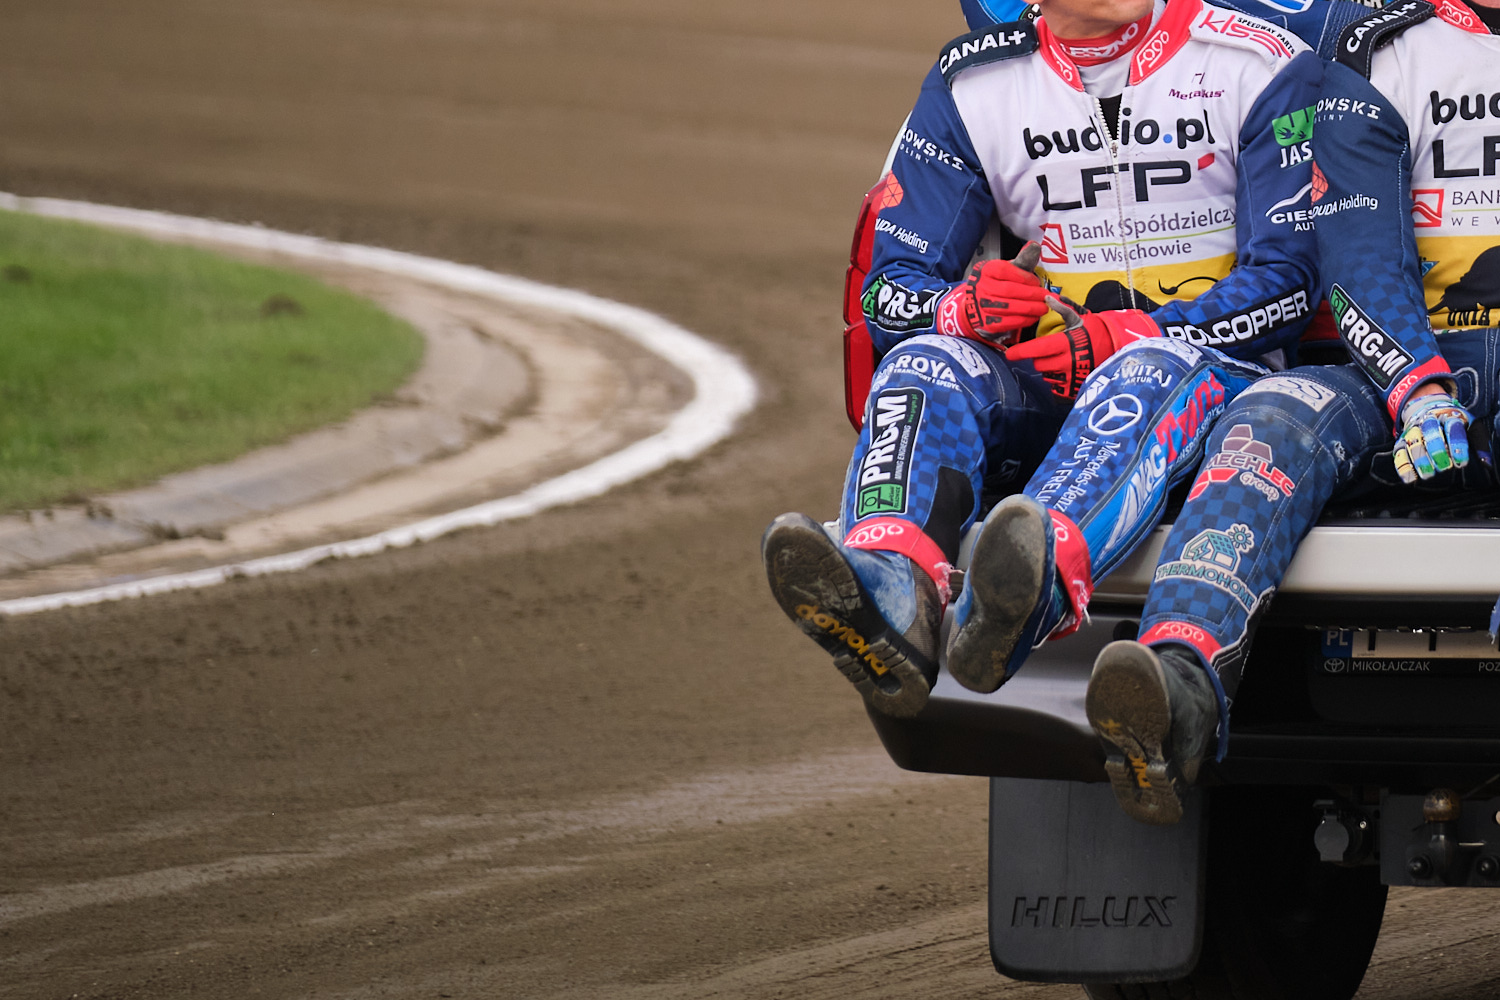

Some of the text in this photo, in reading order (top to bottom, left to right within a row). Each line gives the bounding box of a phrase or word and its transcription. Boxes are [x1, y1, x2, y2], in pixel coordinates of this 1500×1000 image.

[1237, 17, 1296, 56] SPEEDWAY PARTS
[1346, 1, 1418, 53] CANAL+
[939, 30, 1027, 74] CANAL+
[1136, 30, 1170, 77] Fogo
[1022, 108, 1216, 161] budio.pl
[1036, 159, 1192, 213] LFP
[1338, 195, 1379, 211] Holding
[1069, 207, 1237, 241] Bank Spółdzielczy
[1452, 216, 1480, 227] WE
[896, 228, 929, 255] Holding
[1073, 239, 1193, 265] we Wschowie
[1166, 290, 1309, 347] POLCOPPER
[1447, 308, 1490, 328] UNIA
[1340, 307, 1408, 378] PRG-M
[1125, 376, 1154, 385] ARTUR
[861, 394, 908, 487] PRG-M
[1205, 453, 1297, 498] MECHLEC
[1240, 471, 1281, 502] Group
[1155, 563, 1256, 611] THERMOHOME
[1326, 628, 1349, 647] PL
[1351, 660, 1431, 673] MIKOŁAJCZAK
[1010, 895, 1178, 929] HILUX
